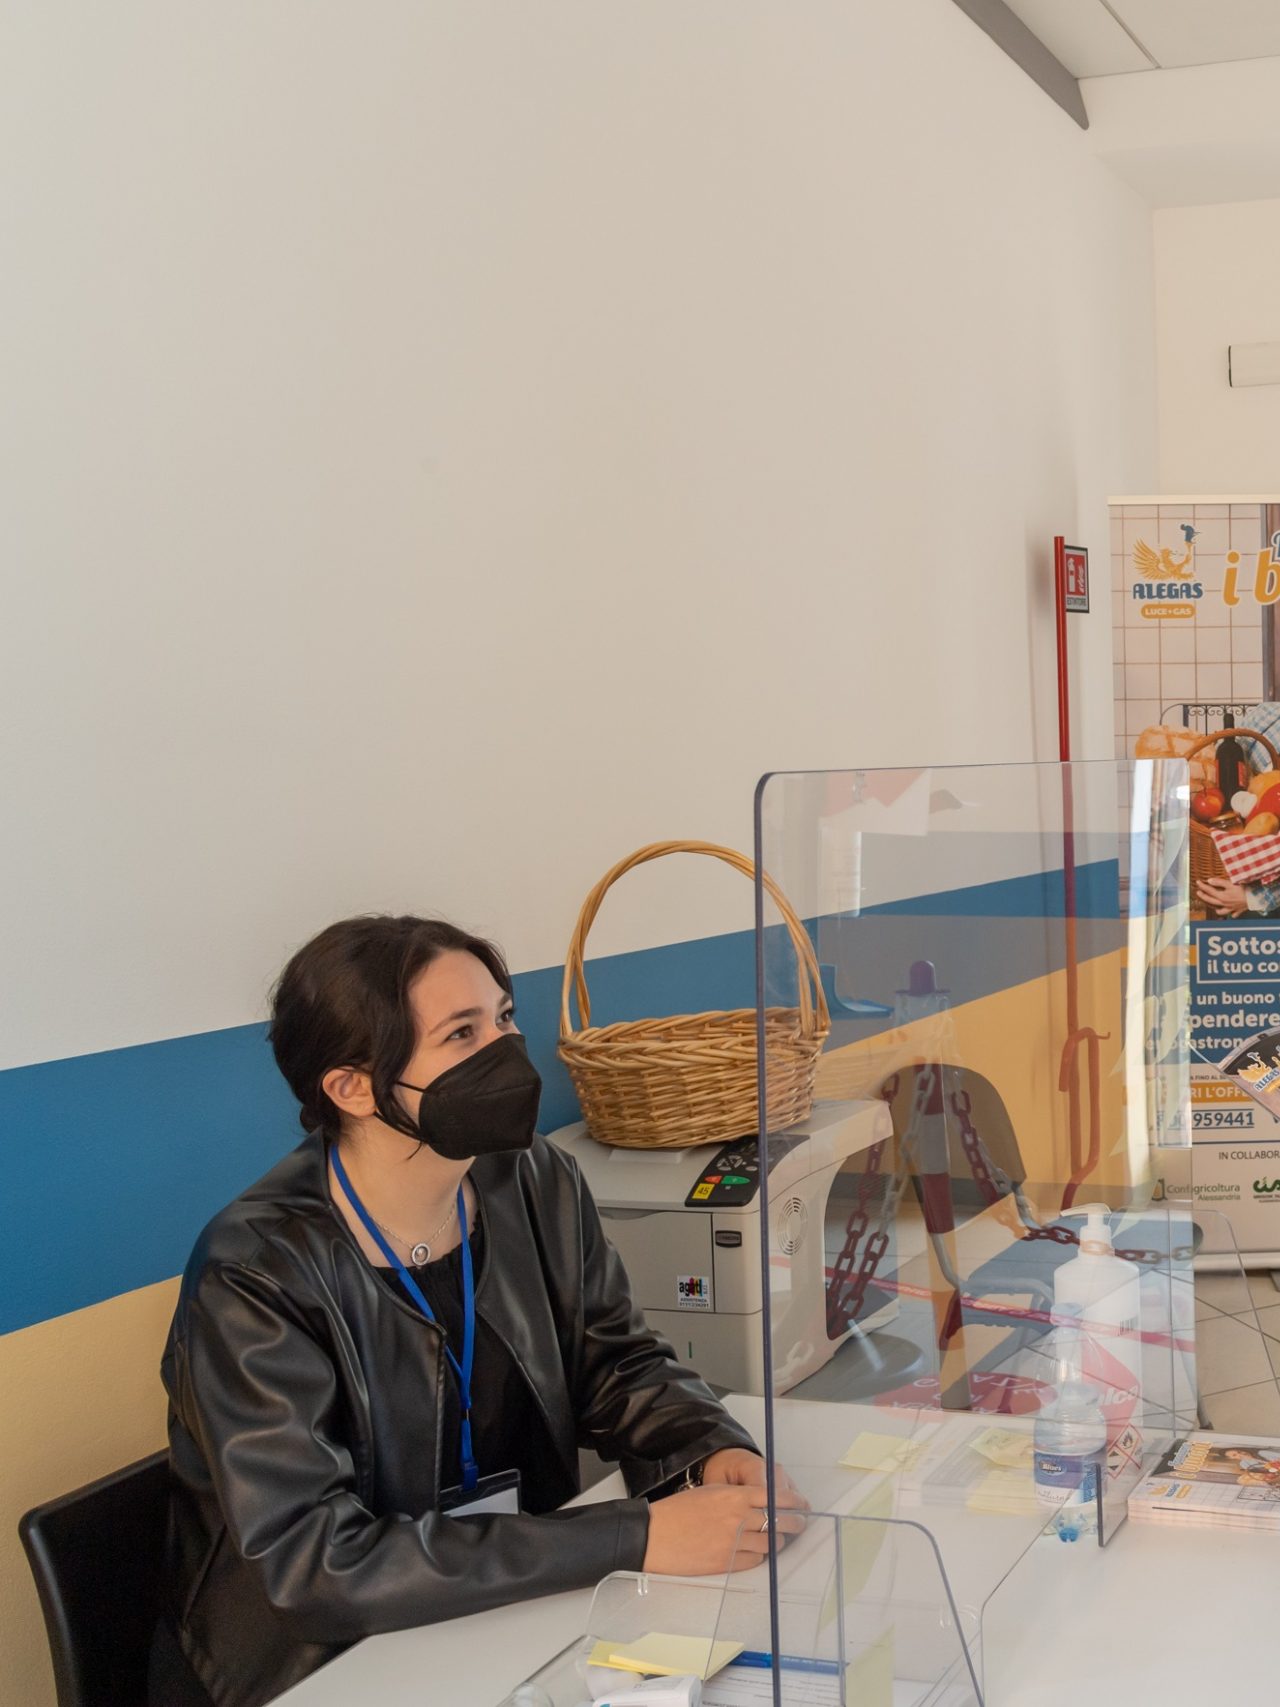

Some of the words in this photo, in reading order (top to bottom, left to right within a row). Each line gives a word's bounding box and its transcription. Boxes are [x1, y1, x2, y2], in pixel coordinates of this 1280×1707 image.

[1223, 551, 1241, 606] i
[1133, 583, 1204, 599] ALEGAS
[1207, 958, 1219, 974] il
[1223, 961, 1253, 974] tuo
[1197, 996, 1218, 1005] un
[1222, 992, 1275, 1004] buono
[1219, 1151, 1229, 1160] IN
